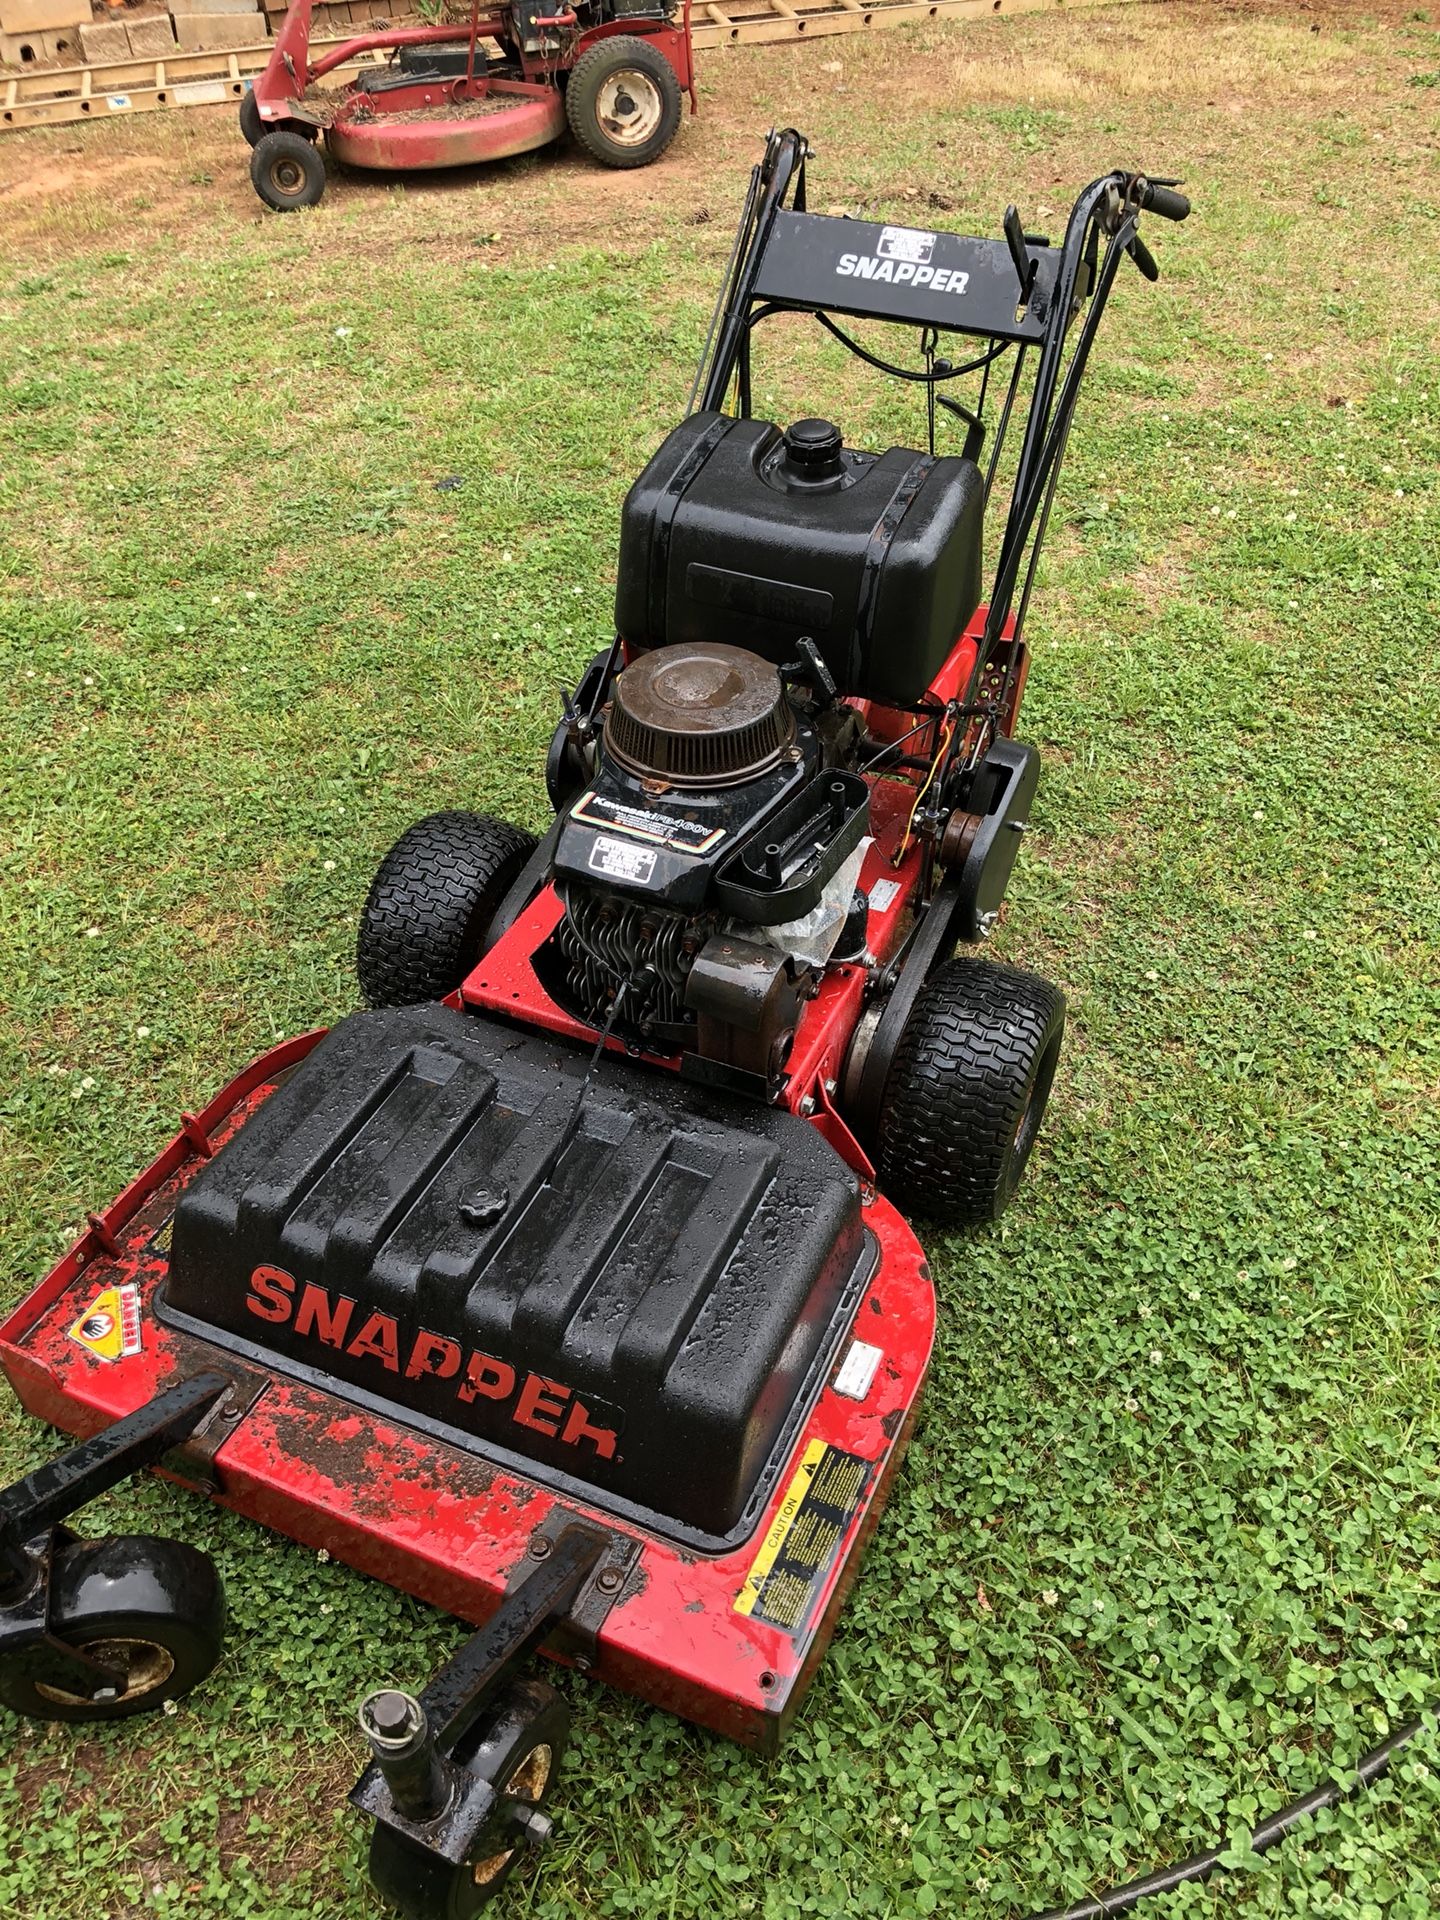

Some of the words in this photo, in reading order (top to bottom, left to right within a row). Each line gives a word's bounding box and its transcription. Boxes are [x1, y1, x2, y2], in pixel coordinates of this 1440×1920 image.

[836, 253, 969, 294] SNAPPER
[592, 796, 657, 821] Kawasaki
[121, 1290, 137, 1348] DANGER
[768, 1498, 797, 1549] CAUTION
